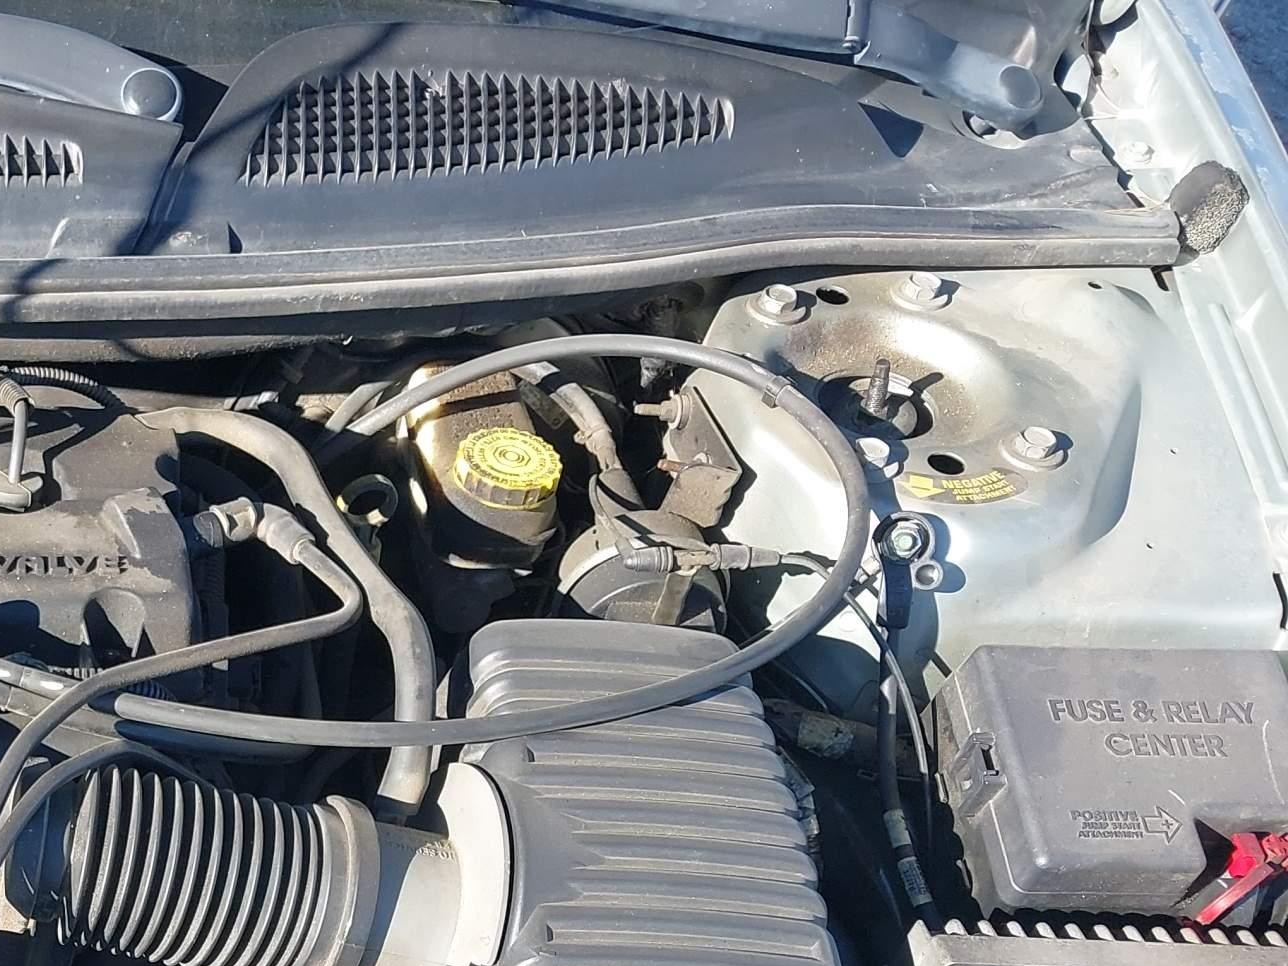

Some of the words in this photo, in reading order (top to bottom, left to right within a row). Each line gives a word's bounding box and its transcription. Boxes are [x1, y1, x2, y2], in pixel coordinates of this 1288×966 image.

[941, 470, 1006, 489] NEGATIVE
[952, 486, 981, 496] JUMP
[983, 480, 1010, 493] START
[956, 485, 1016, 502] ATTACHMENT
[1048, 699, 1125, 723] FUSE
[1131, 699, 1158, 723] &
[1161, 700, 1255, 725] RELAY
[1104, 732, 1229, 758] CENTER
[1070, 809, 1139, 823] POSITIVE
[1112, 821, 1142, 831] START
[1078, 830, 1144, 839] ATTACHMENT
